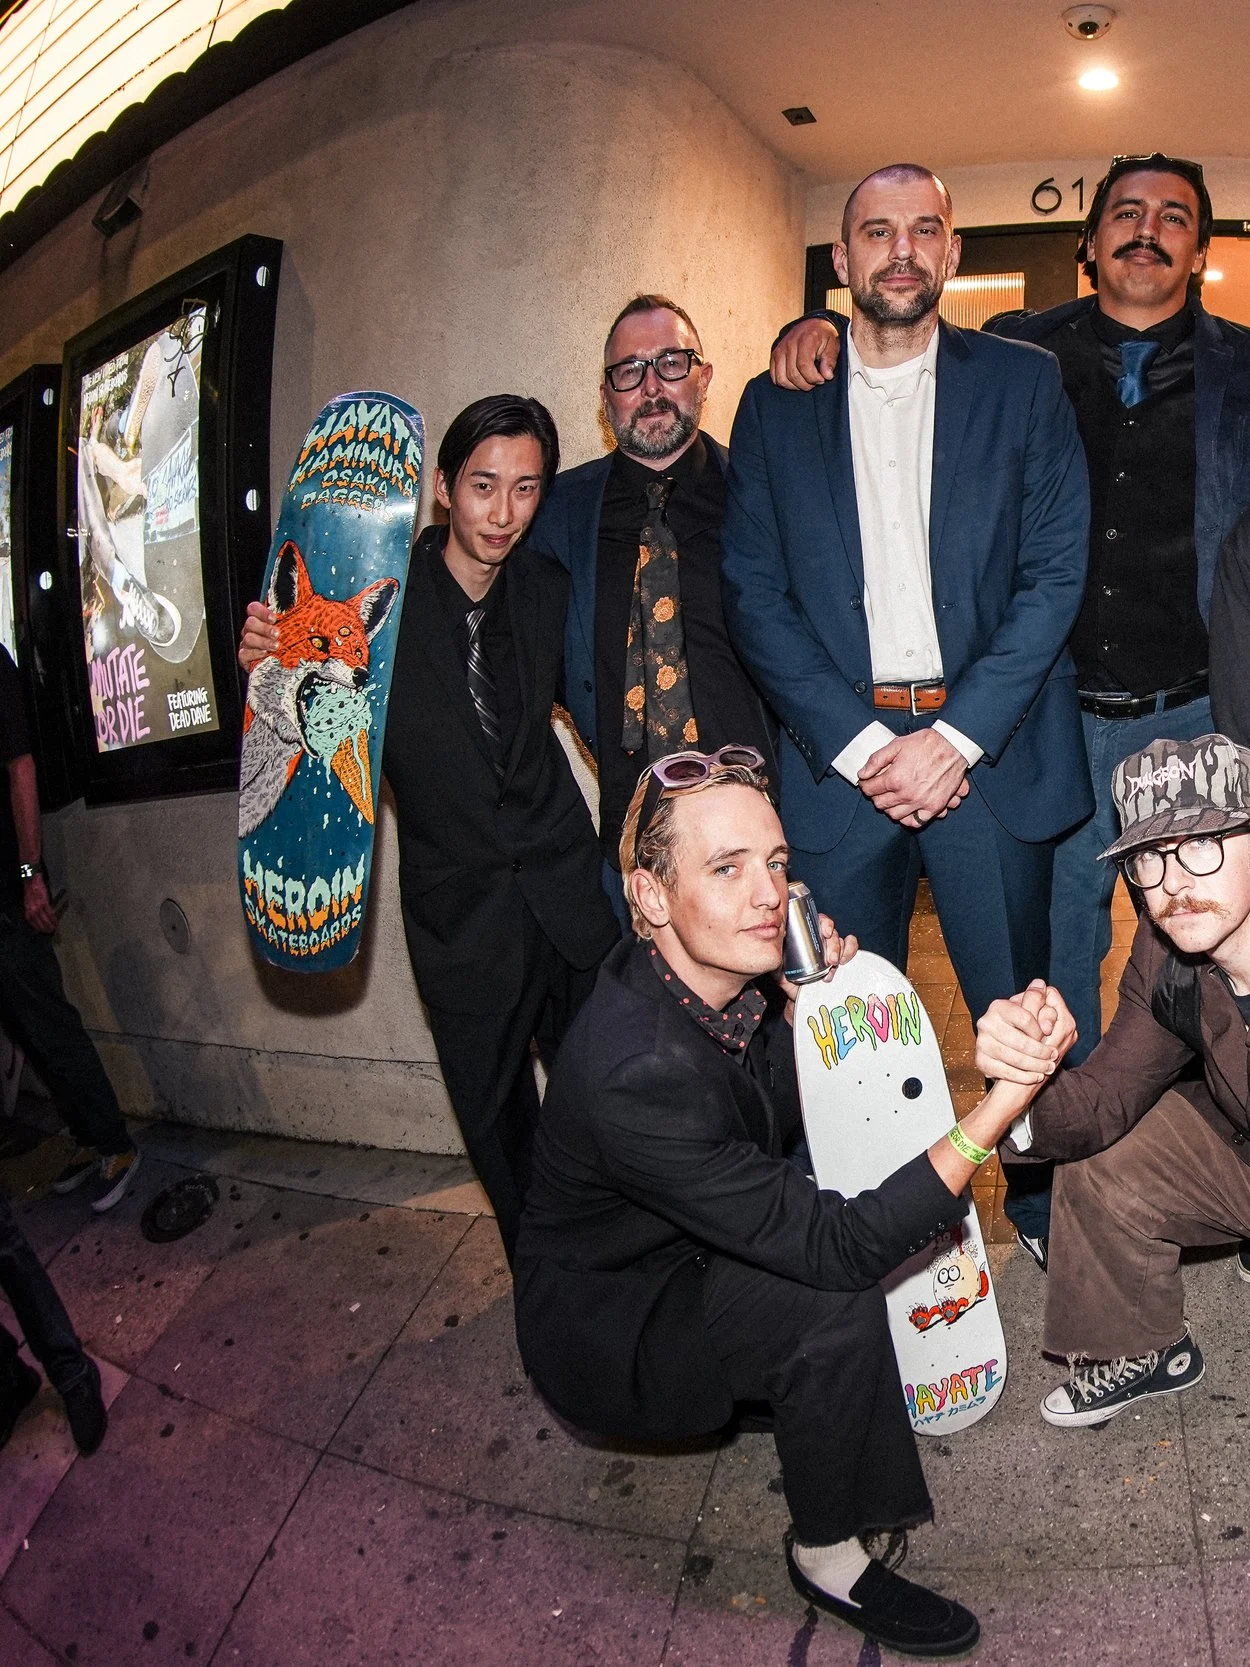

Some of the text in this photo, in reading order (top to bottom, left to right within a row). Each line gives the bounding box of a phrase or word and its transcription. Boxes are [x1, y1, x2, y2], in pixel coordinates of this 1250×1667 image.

[321, 469, 388, 500] OSAKA
[91, 643, 150, 702] MUTATE
[167, 686, 208, 711] FEATURING
[97, 694, 151, 744] OR DIE
[168, 703, 212, 732] DEAD DAVE
[243, 849, 365, 934] HEROIN
[245, 892, 362, 957] SKATEBOARDS
[807, 991, 922, 1070] HEROIN
